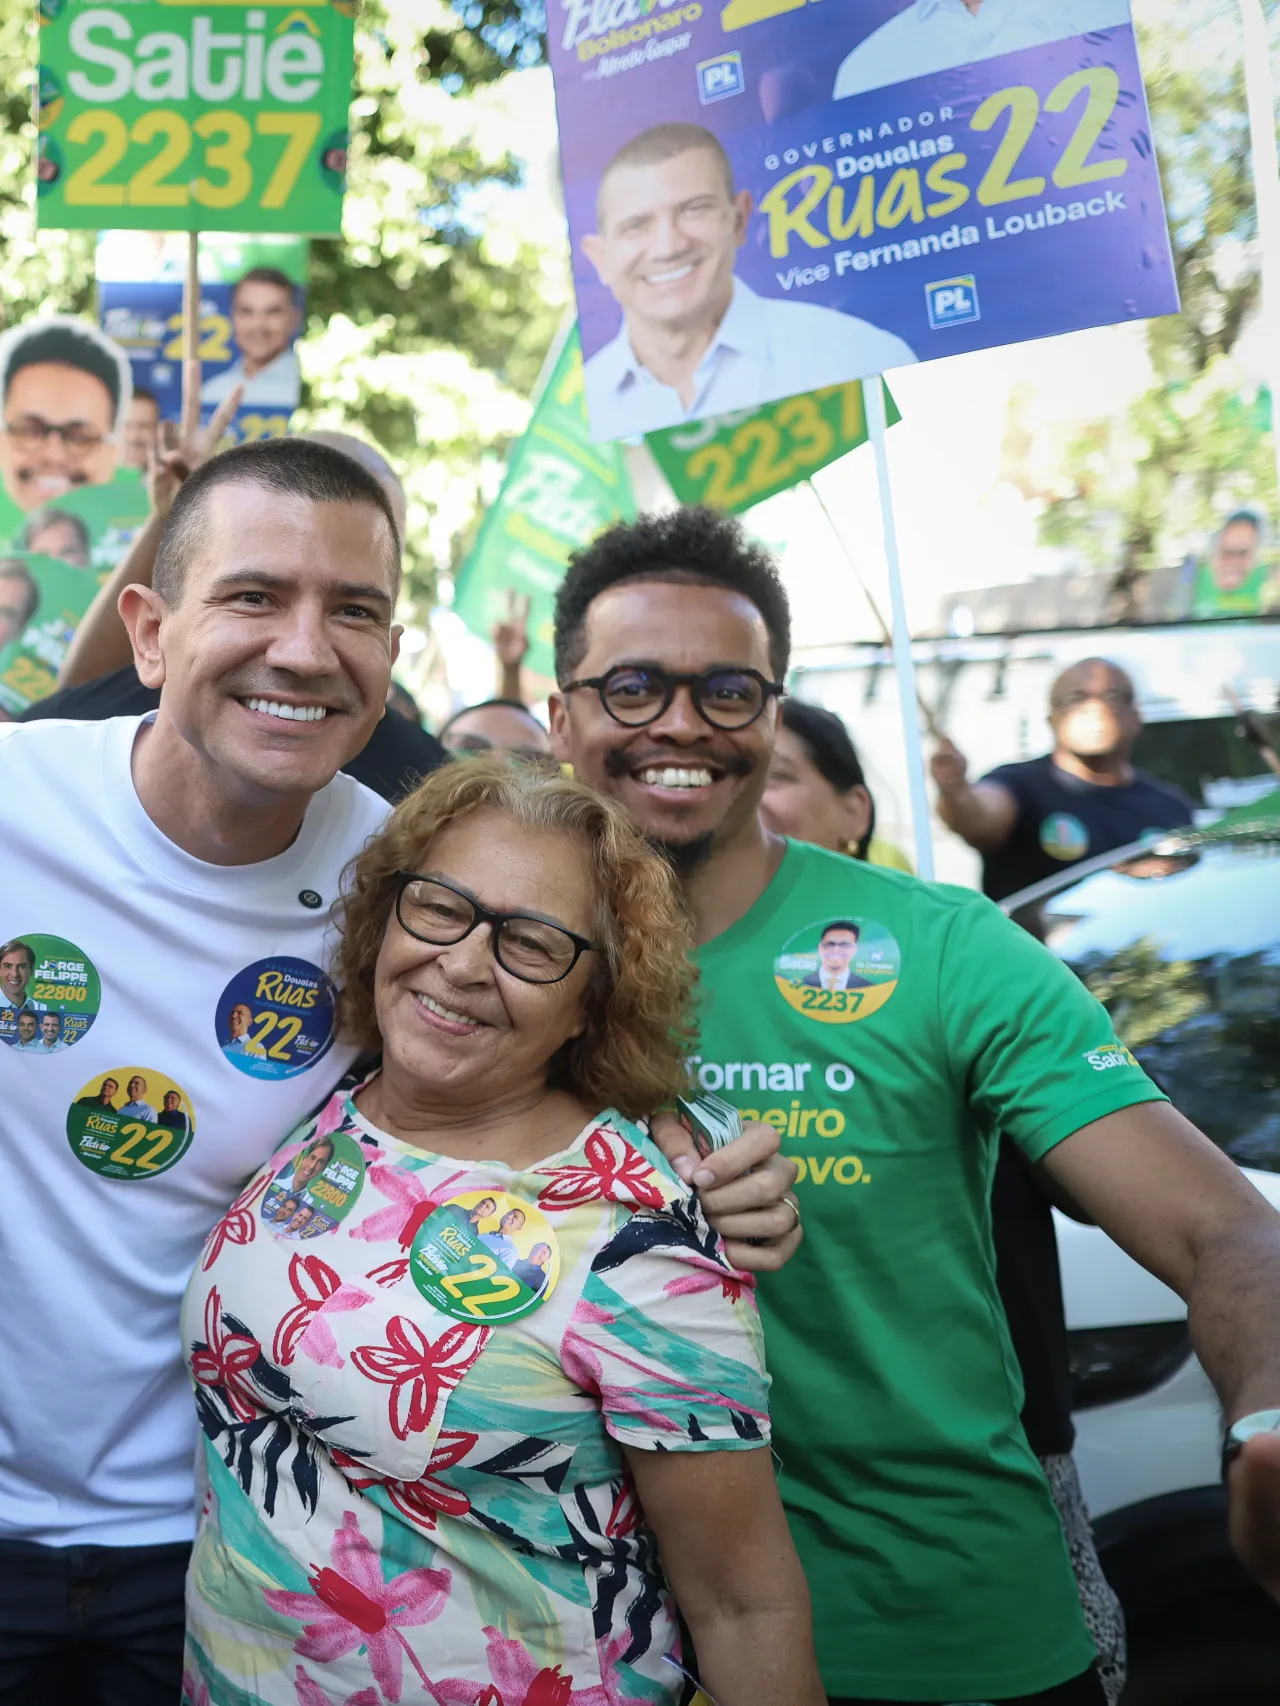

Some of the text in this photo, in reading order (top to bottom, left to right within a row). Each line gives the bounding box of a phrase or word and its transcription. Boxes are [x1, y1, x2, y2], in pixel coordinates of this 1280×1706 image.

[577, 2, 703, 62] Bolsonaro
[66, 9, 325, 102] Satiê
[705, 62, 738, 91] PL
[764, 105, 954, 171] GOVERNADOR
[64, 109, 322, 209] 2237
[758, 66, 1128, 259] Ruas 22
[835, 134, 955, 180] Douglas
[775, 190, 1128, 292] Vice Fernanda Louback
[934, 286, 972, 316] PL
[34, 969, 88, 983] FELIPPE
[39, 960, 85, 972] JORGE
[33, 983, 87, 1002] 22800
[255, 971, 320, 1008] Ruas
[284, 974, 318, 988] Douglas
[1, 1011, 15, 1021] 22
[801, 989, 865, 1014] 2237
[63, 1030, 77, 1043] 22
[64, 1016, 88, 1029] Ruas
[244, 1011, 303, 1061] 22
[1087, 1051, 1129, 1071] Sat
[825, 1063, 855, 1092] o
[738, 1101, 845, 1138] neiro
[86, 1115, 173, 1171] Ruas 22
[322, 1167, 356, 1191] FELIPPE
[790, 1156, 872, 1185] ovo.
[310, 1180, 348, 1208] 22800
[299, 1225, 315, 1239] 22
[311, 1215, 330, 1231] Ruas
[438, 1226, 470, 1256] Ruas
[419, 1243, 449, 1271] Flávio
[440, 1254, 521, 1317] 22
